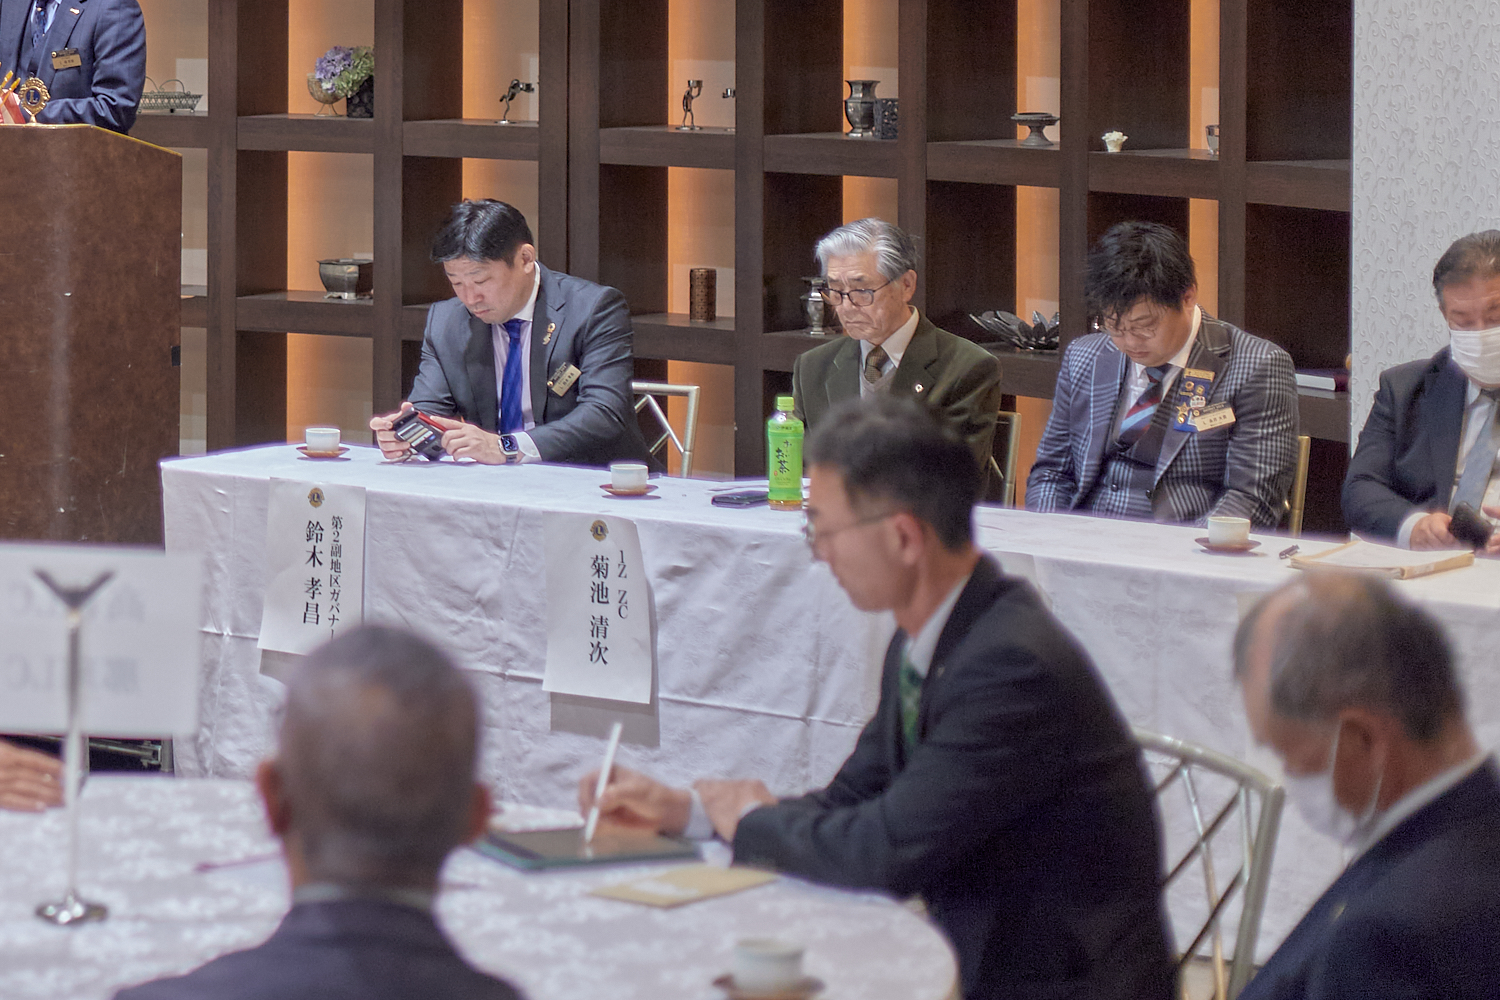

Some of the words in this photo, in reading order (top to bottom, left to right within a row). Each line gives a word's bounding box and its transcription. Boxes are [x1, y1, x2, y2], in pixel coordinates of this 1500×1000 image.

[304, 519, 325, 568] 鈴木
[617, 549, 628, 579] 1Z
[303, 577, 322, 625] 孝昌
[328, 515, 343, 639] 第2副地区ガバナー
[590, 554, 610, 605] 菊池
[617, 589, 629, 619] ZC
[589, 614, 610, 666] 清次
